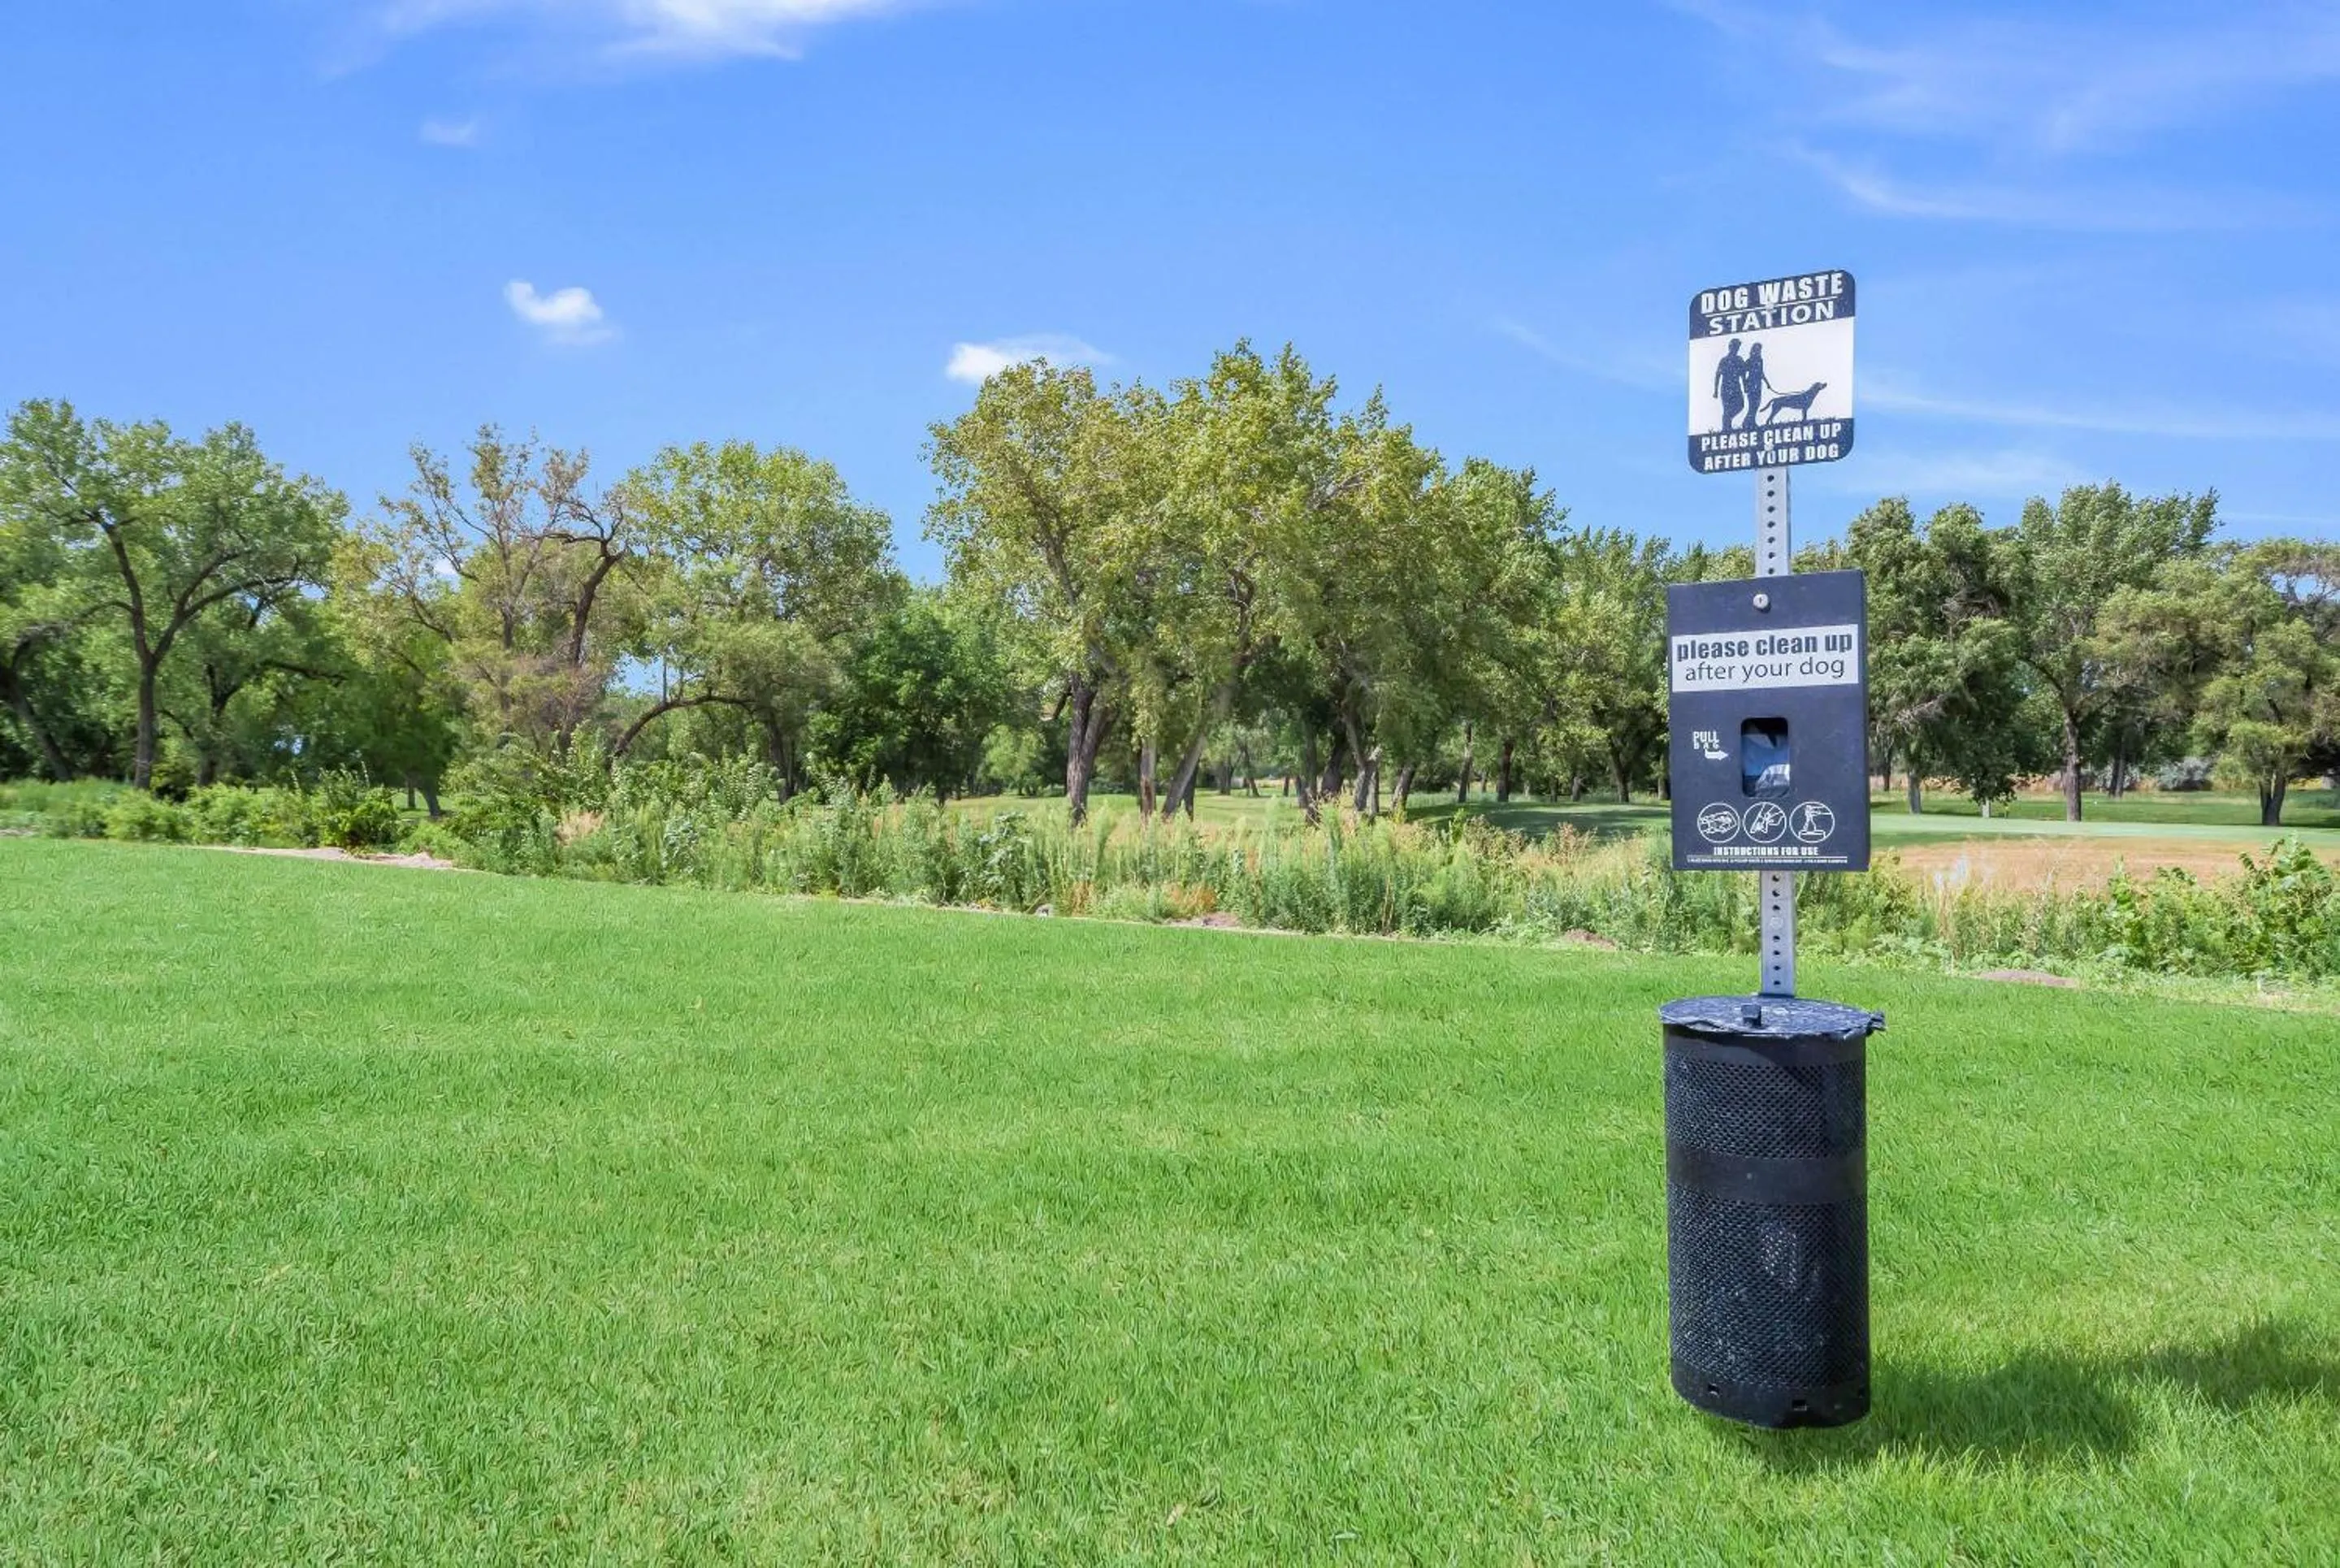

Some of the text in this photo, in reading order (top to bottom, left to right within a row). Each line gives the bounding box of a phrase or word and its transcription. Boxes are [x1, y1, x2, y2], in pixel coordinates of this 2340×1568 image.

[1701, 272, 1844, 314] DOG WASTE
[1709, 301, 1835, 336] STATION
[1701, 422, 1843, 452] PLEASE CLEAN UP
[1703, 443, 1840, 471] AFTER YOUR DOG
[1676, 634, 1853, 662] please clean up
[1685, 656, 1846, 683] after your dog
[1693, 730, 1719, 743] PULL
[1714, 847, 1819, 856] INSTRUCTIONS FOR USE
